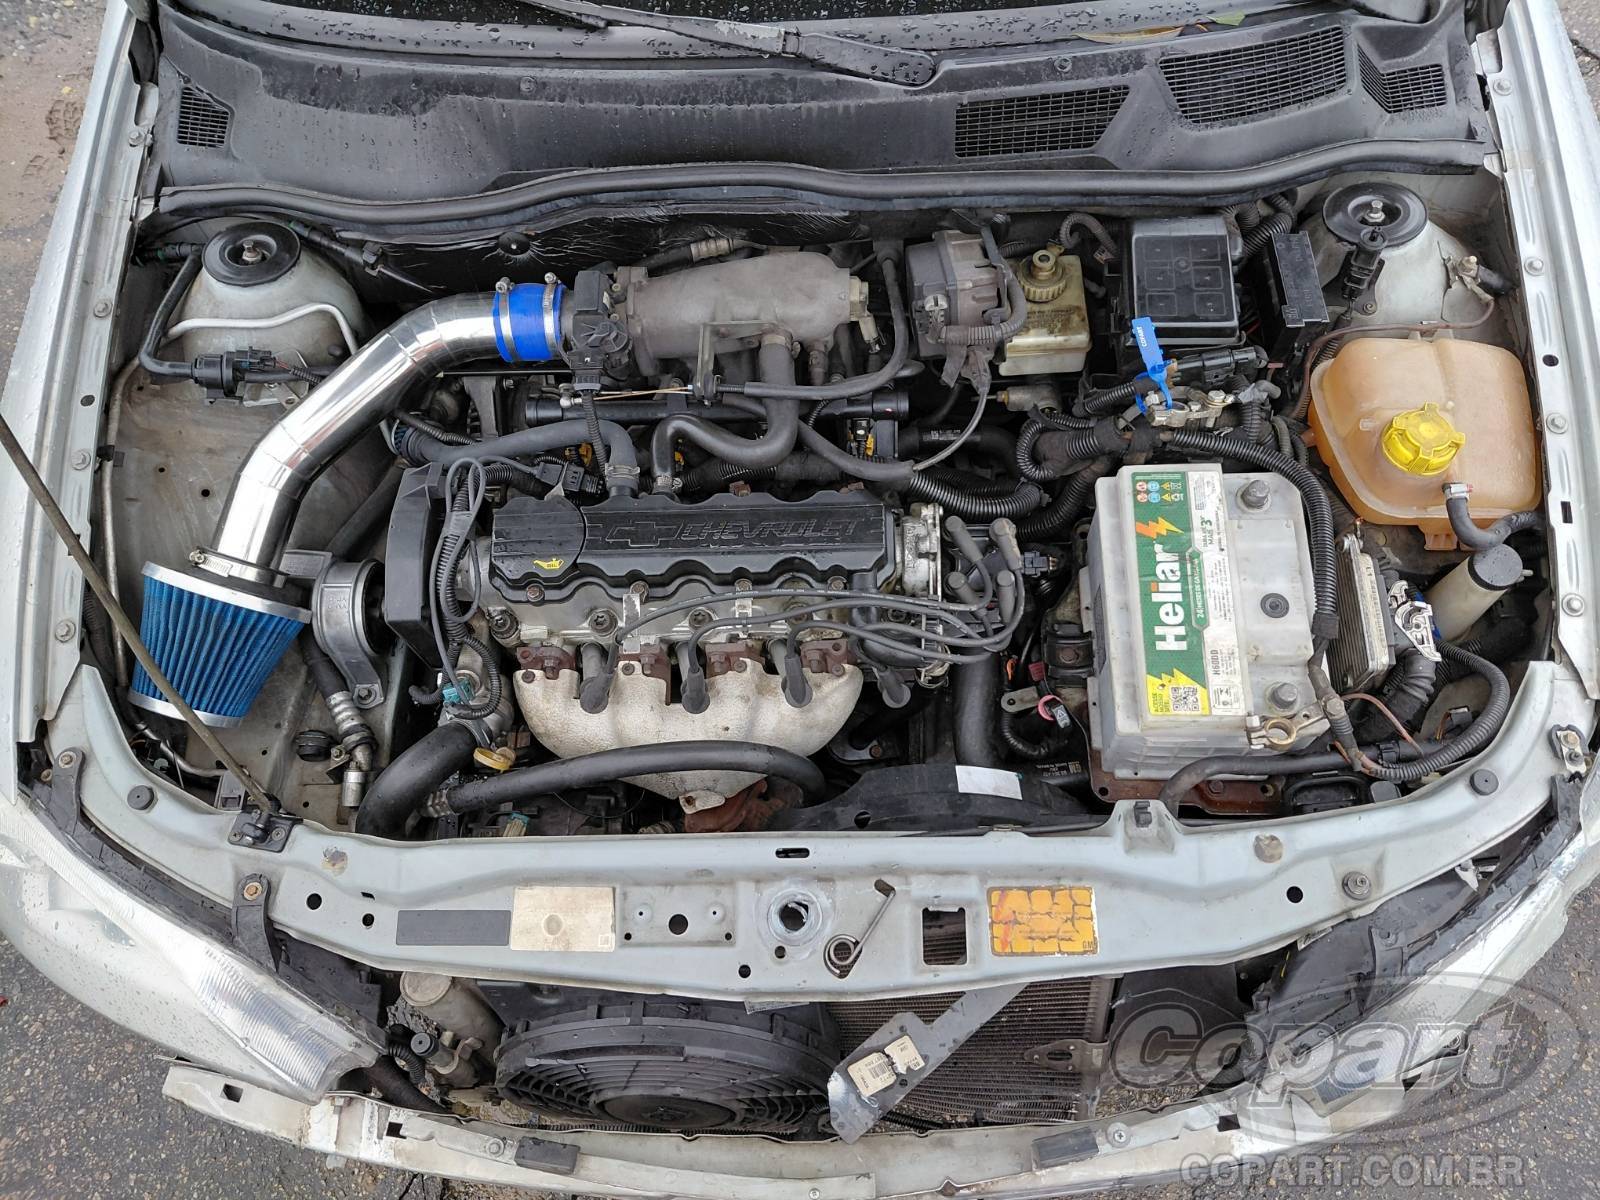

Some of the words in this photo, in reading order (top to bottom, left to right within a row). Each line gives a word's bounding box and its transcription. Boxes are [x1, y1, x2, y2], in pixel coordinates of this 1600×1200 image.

[1136, 326, 1147, 347] COPART
[680, 518, 865, 541] CHEVROLET
[1150, 543, 1187, 650] Heliar
[1196, 609, 1204, 619] 24
